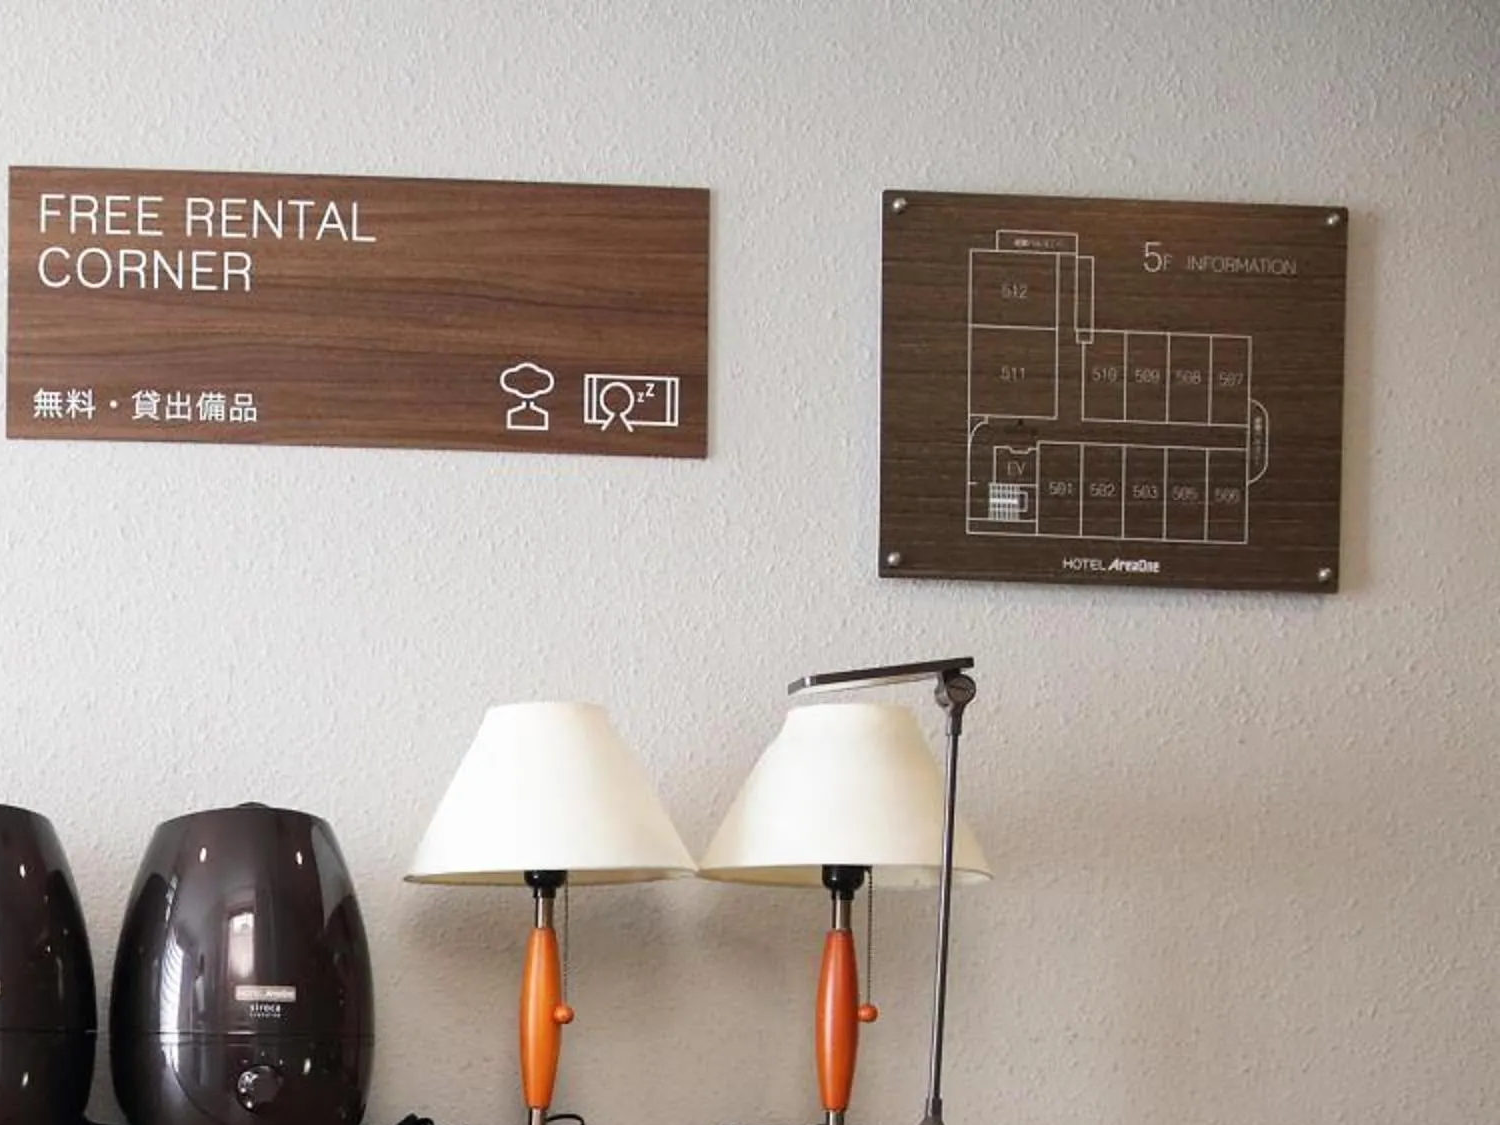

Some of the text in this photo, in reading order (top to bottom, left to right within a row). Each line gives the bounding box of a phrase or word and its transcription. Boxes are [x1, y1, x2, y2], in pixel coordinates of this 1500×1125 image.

[37, 192, 377, 243] FREE RENTAL
[37, 246, 253, 292] CORNER
[1187, 254, 1298, 275] INFORMATION
[1001, 283, 1029, 299] 512
[1091, 366, 1119, 383] 510
[33, 387, 258, 423] 無料・貸出備品
[1049, 481, 1074, 496] 501
[1089, 482, 1117, 497] 502
[1062, 556, 1106, 571] HOTEL
